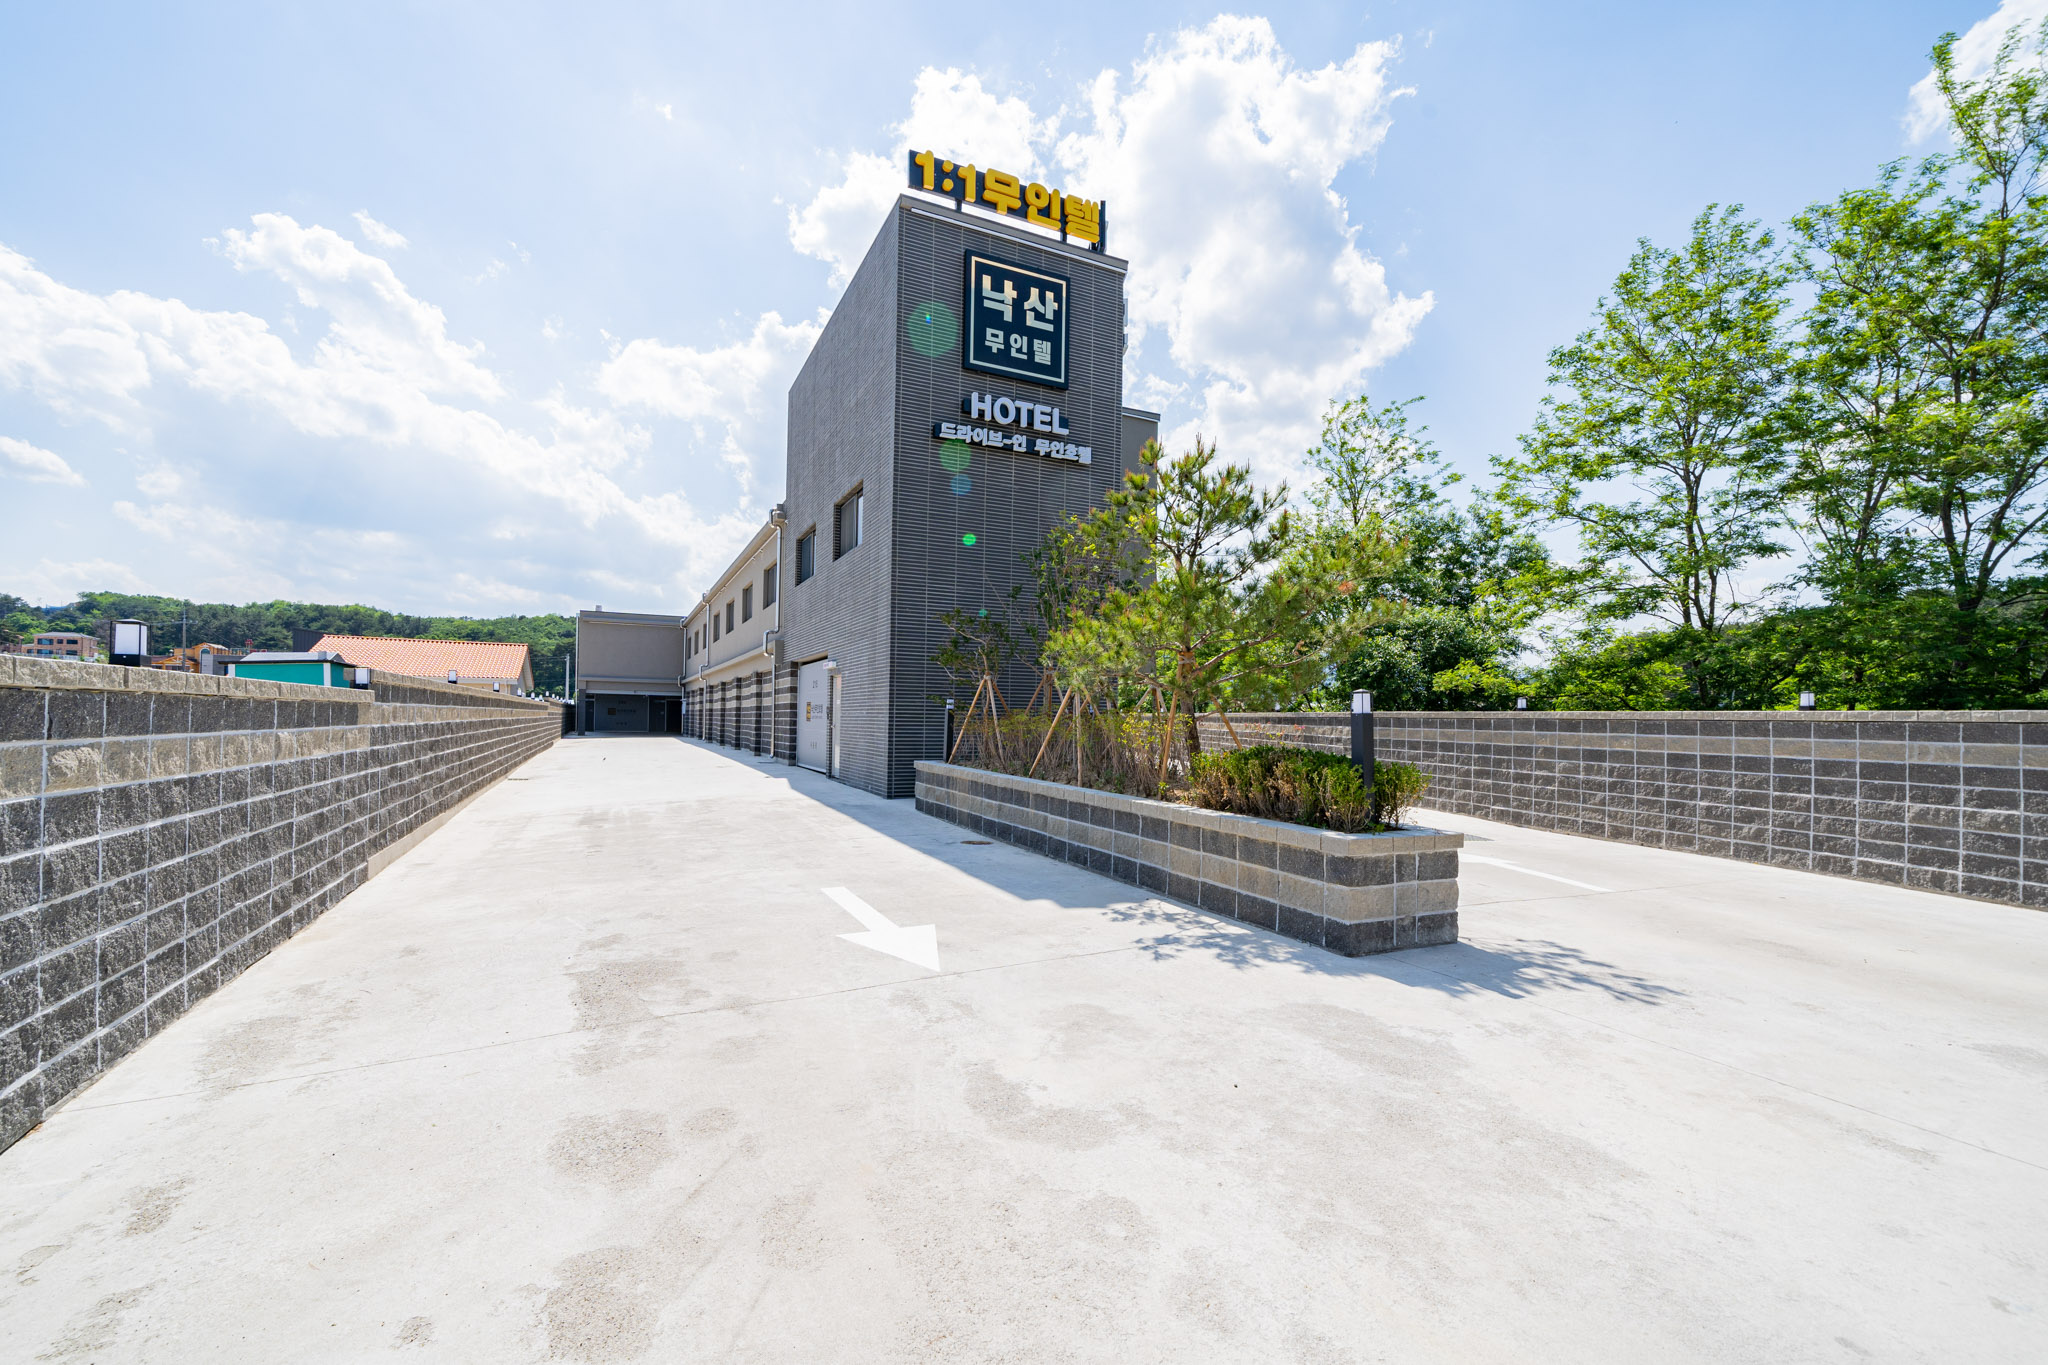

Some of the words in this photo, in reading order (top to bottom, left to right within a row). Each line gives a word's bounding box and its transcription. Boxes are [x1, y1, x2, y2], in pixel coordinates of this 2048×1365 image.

[915, 150, 1100, 243] 1:1무인텔
[982, 274, 1058, 332] 낙산
[985, 327, 1051, 365] 무인텔
[971, 392, 1069, 435] HOTEL
[939, 422, 1027, 452] 드라이브-인
[1034, 438, 1092, 464] 무인호텔
